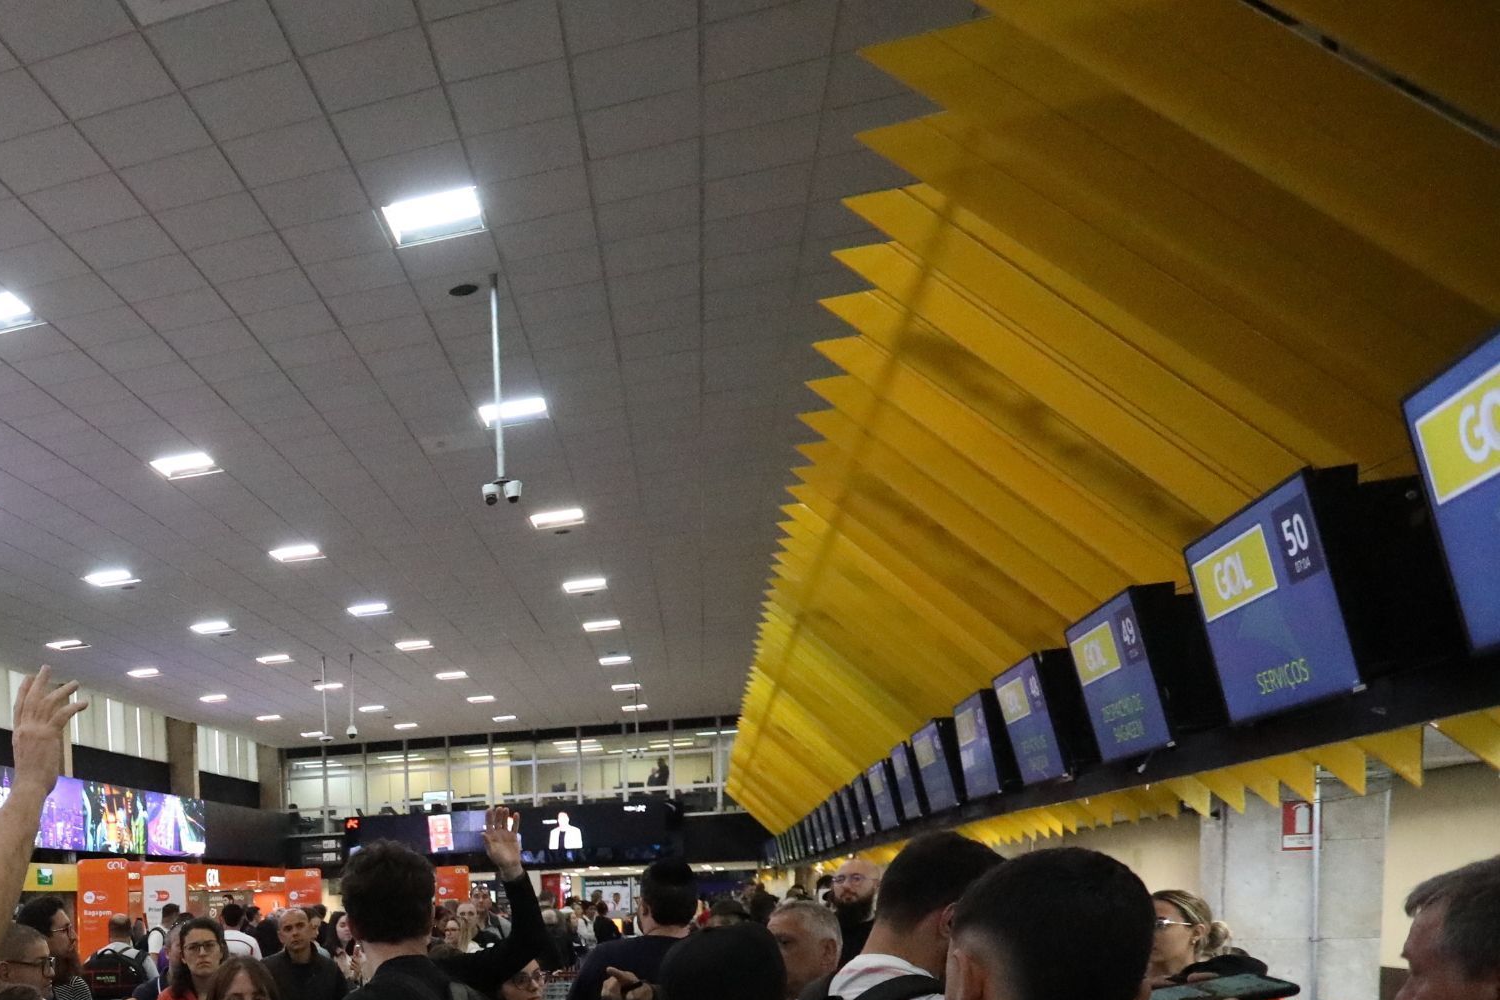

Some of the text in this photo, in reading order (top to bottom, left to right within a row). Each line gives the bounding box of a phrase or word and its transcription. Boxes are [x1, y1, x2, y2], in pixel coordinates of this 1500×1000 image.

[1281, 513, 1309, 557] 50
[1213, 551, 1253, 601] GOL
[1121, 616, 1136, 646] 49
[1256, 658, 1310, 694] SERVIÇOS
[106, 861, 125, 870] GOL
[169, 865, 186, 873] GOL
